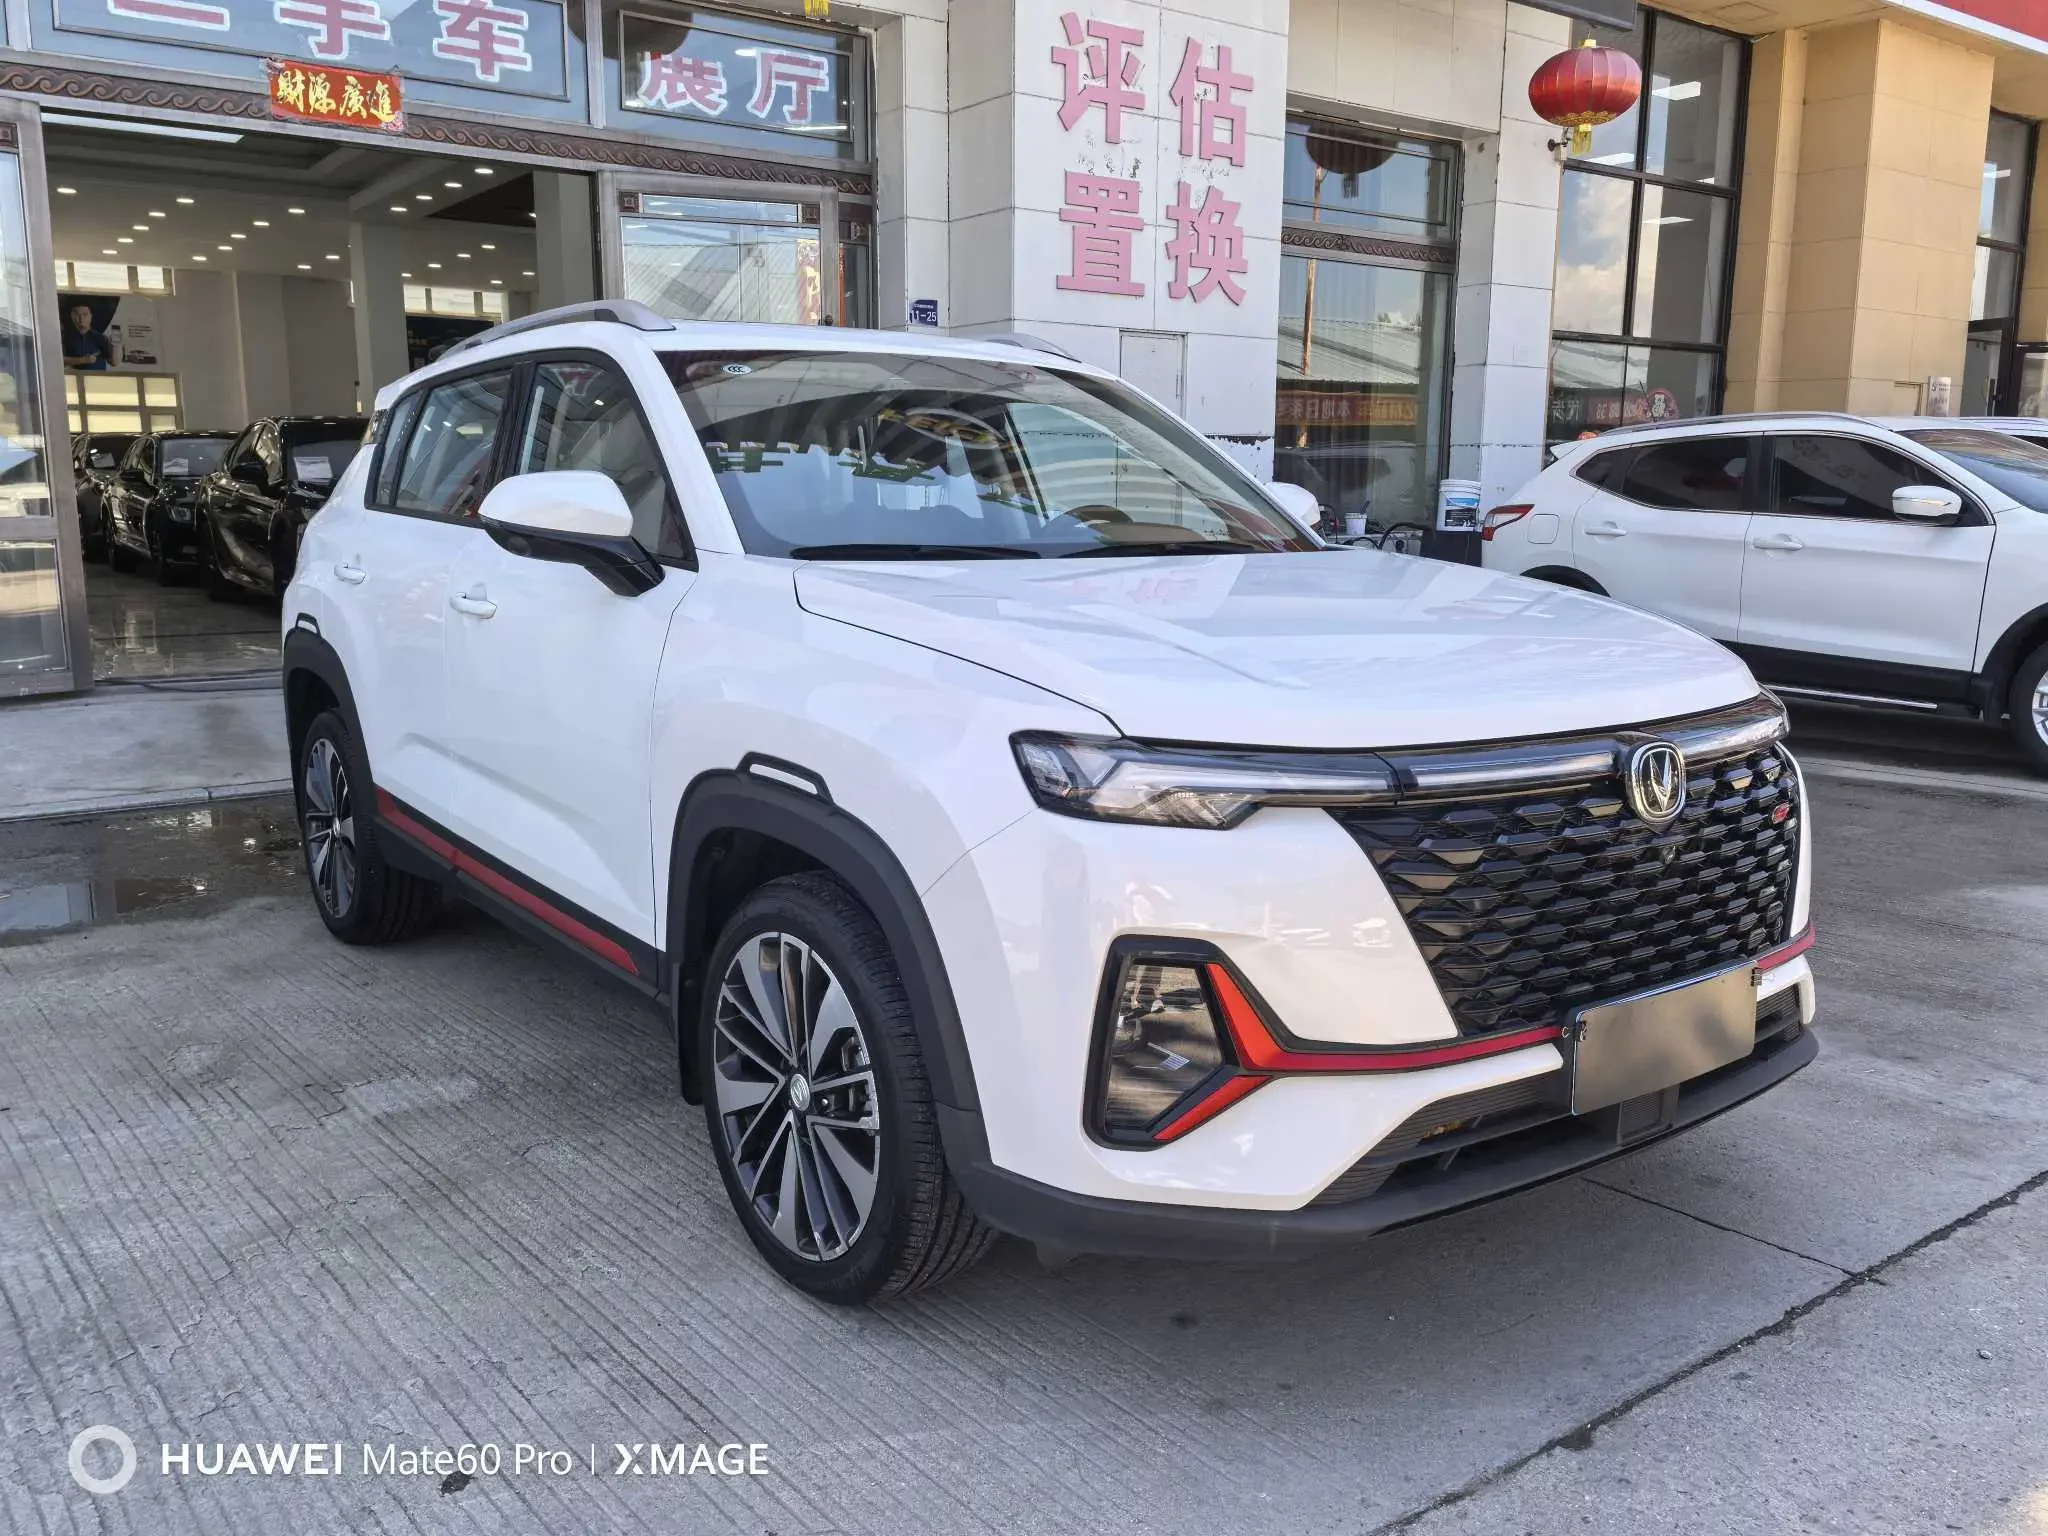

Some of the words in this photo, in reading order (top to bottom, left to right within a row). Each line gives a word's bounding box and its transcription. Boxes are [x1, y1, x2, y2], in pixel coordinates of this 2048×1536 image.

[638, 48, 829, 123] 展厅
[1051, 11, 1255, 168] 评估
[1056, 168, 1248, 306] 置换
